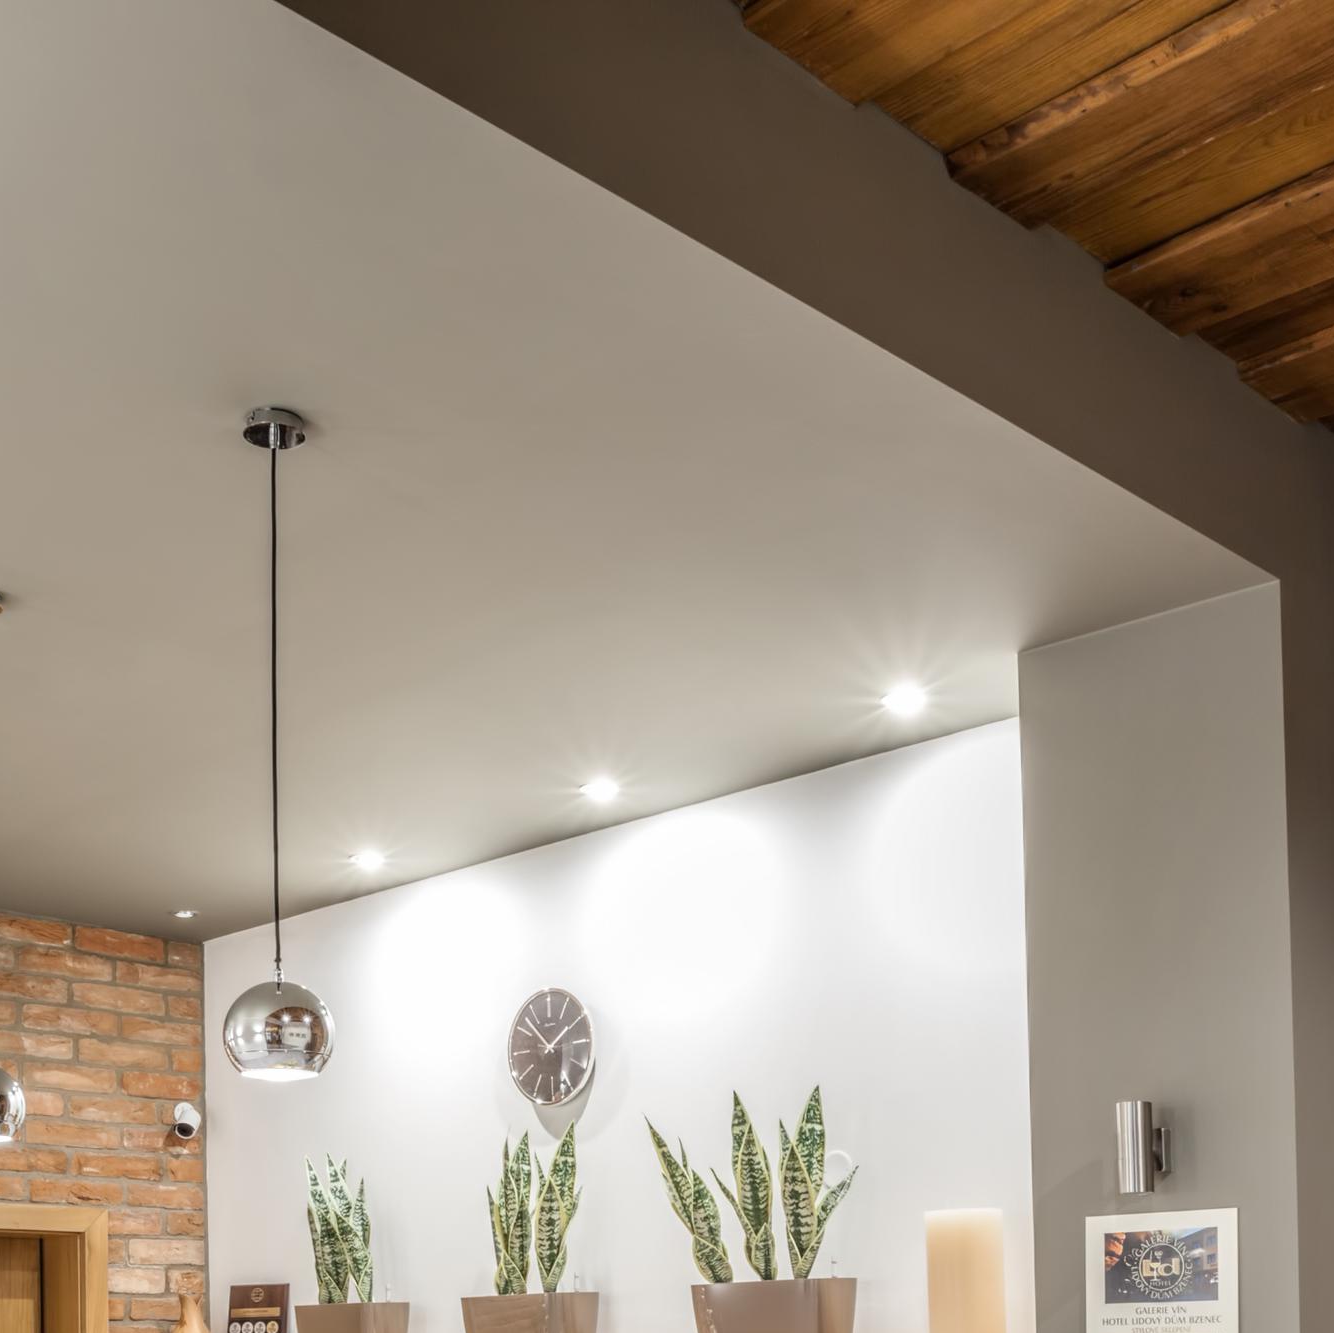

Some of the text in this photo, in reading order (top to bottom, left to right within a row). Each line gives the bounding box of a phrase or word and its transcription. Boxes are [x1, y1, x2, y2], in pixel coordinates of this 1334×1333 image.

[1135, 1234, 1171, 1257] GALERIE
[1102, 1315, 1222, 1326] HOTEL LIDOVÝ DŮM BZENEC
